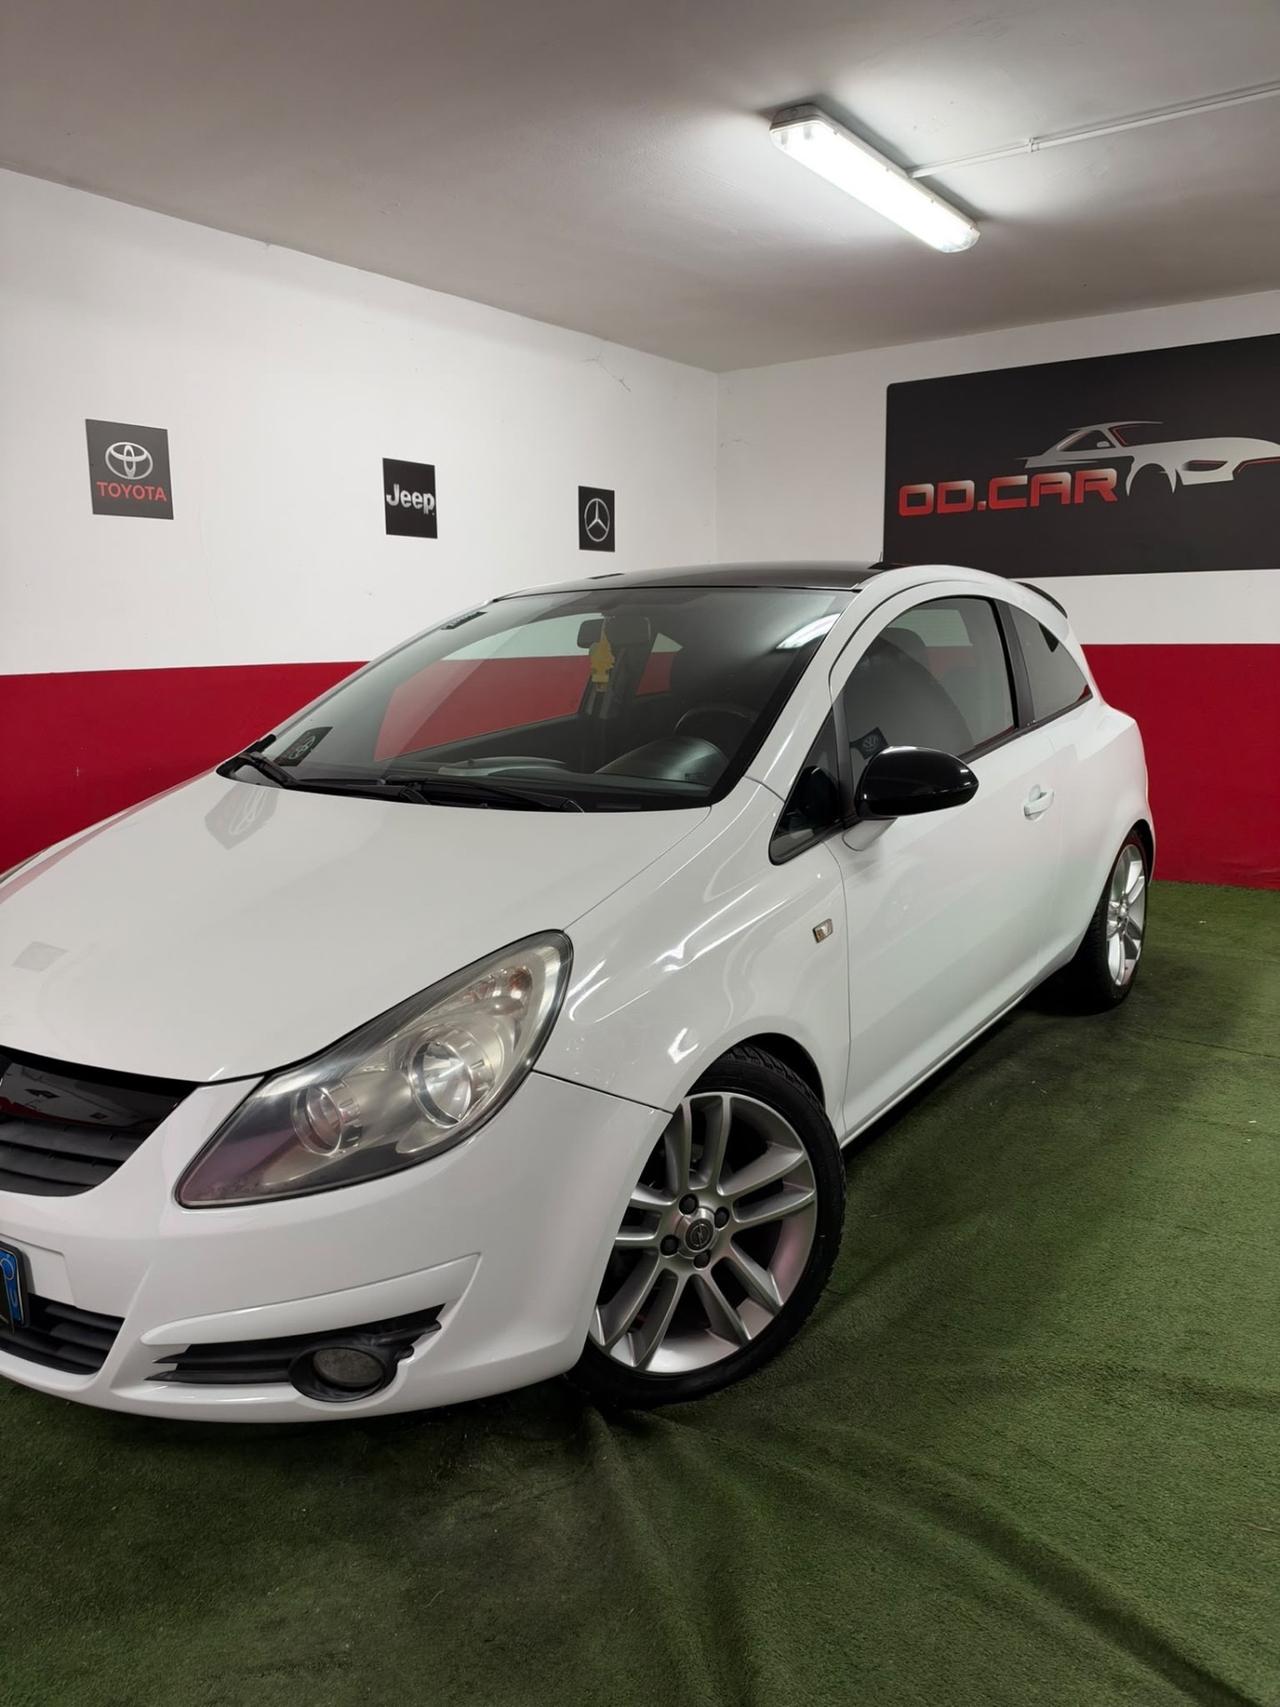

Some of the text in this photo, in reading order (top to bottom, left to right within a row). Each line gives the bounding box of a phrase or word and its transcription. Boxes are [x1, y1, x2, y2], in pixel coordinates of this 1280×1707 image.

[96, 481, 167, 502] TOYOTA
[386, 483, 435, 514] Jeep
[898, 468, 1118, 516] OD.CAR
